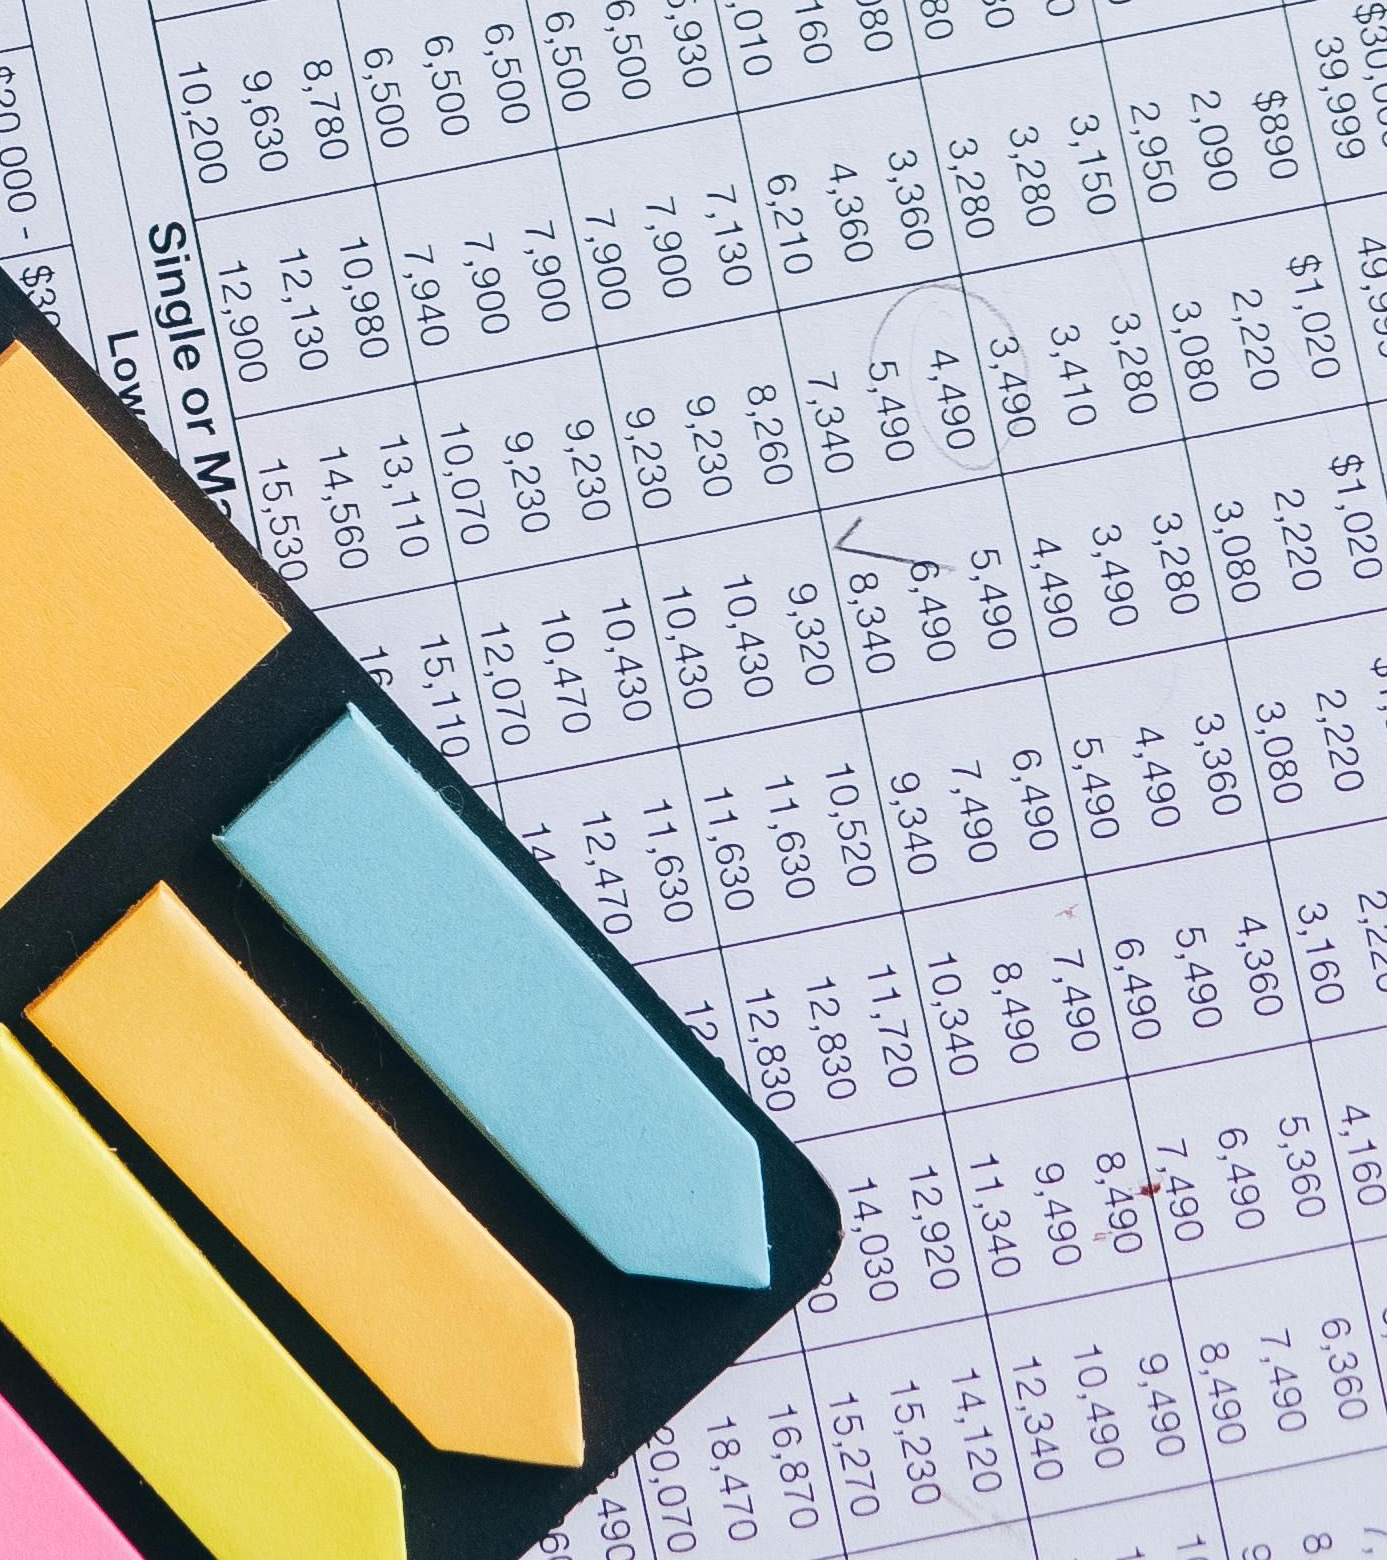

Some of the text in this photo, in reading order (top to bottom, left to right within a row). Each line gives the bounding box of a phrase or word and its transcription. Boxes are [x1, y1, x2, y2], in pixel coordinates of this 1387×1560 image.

[147, 220, 217, 437] Single or
[217, 259, 269, 384] 12,900
[1295, 902, 1346, 1006] 3,160
[847, 1176, 900, 1303] 14,030
